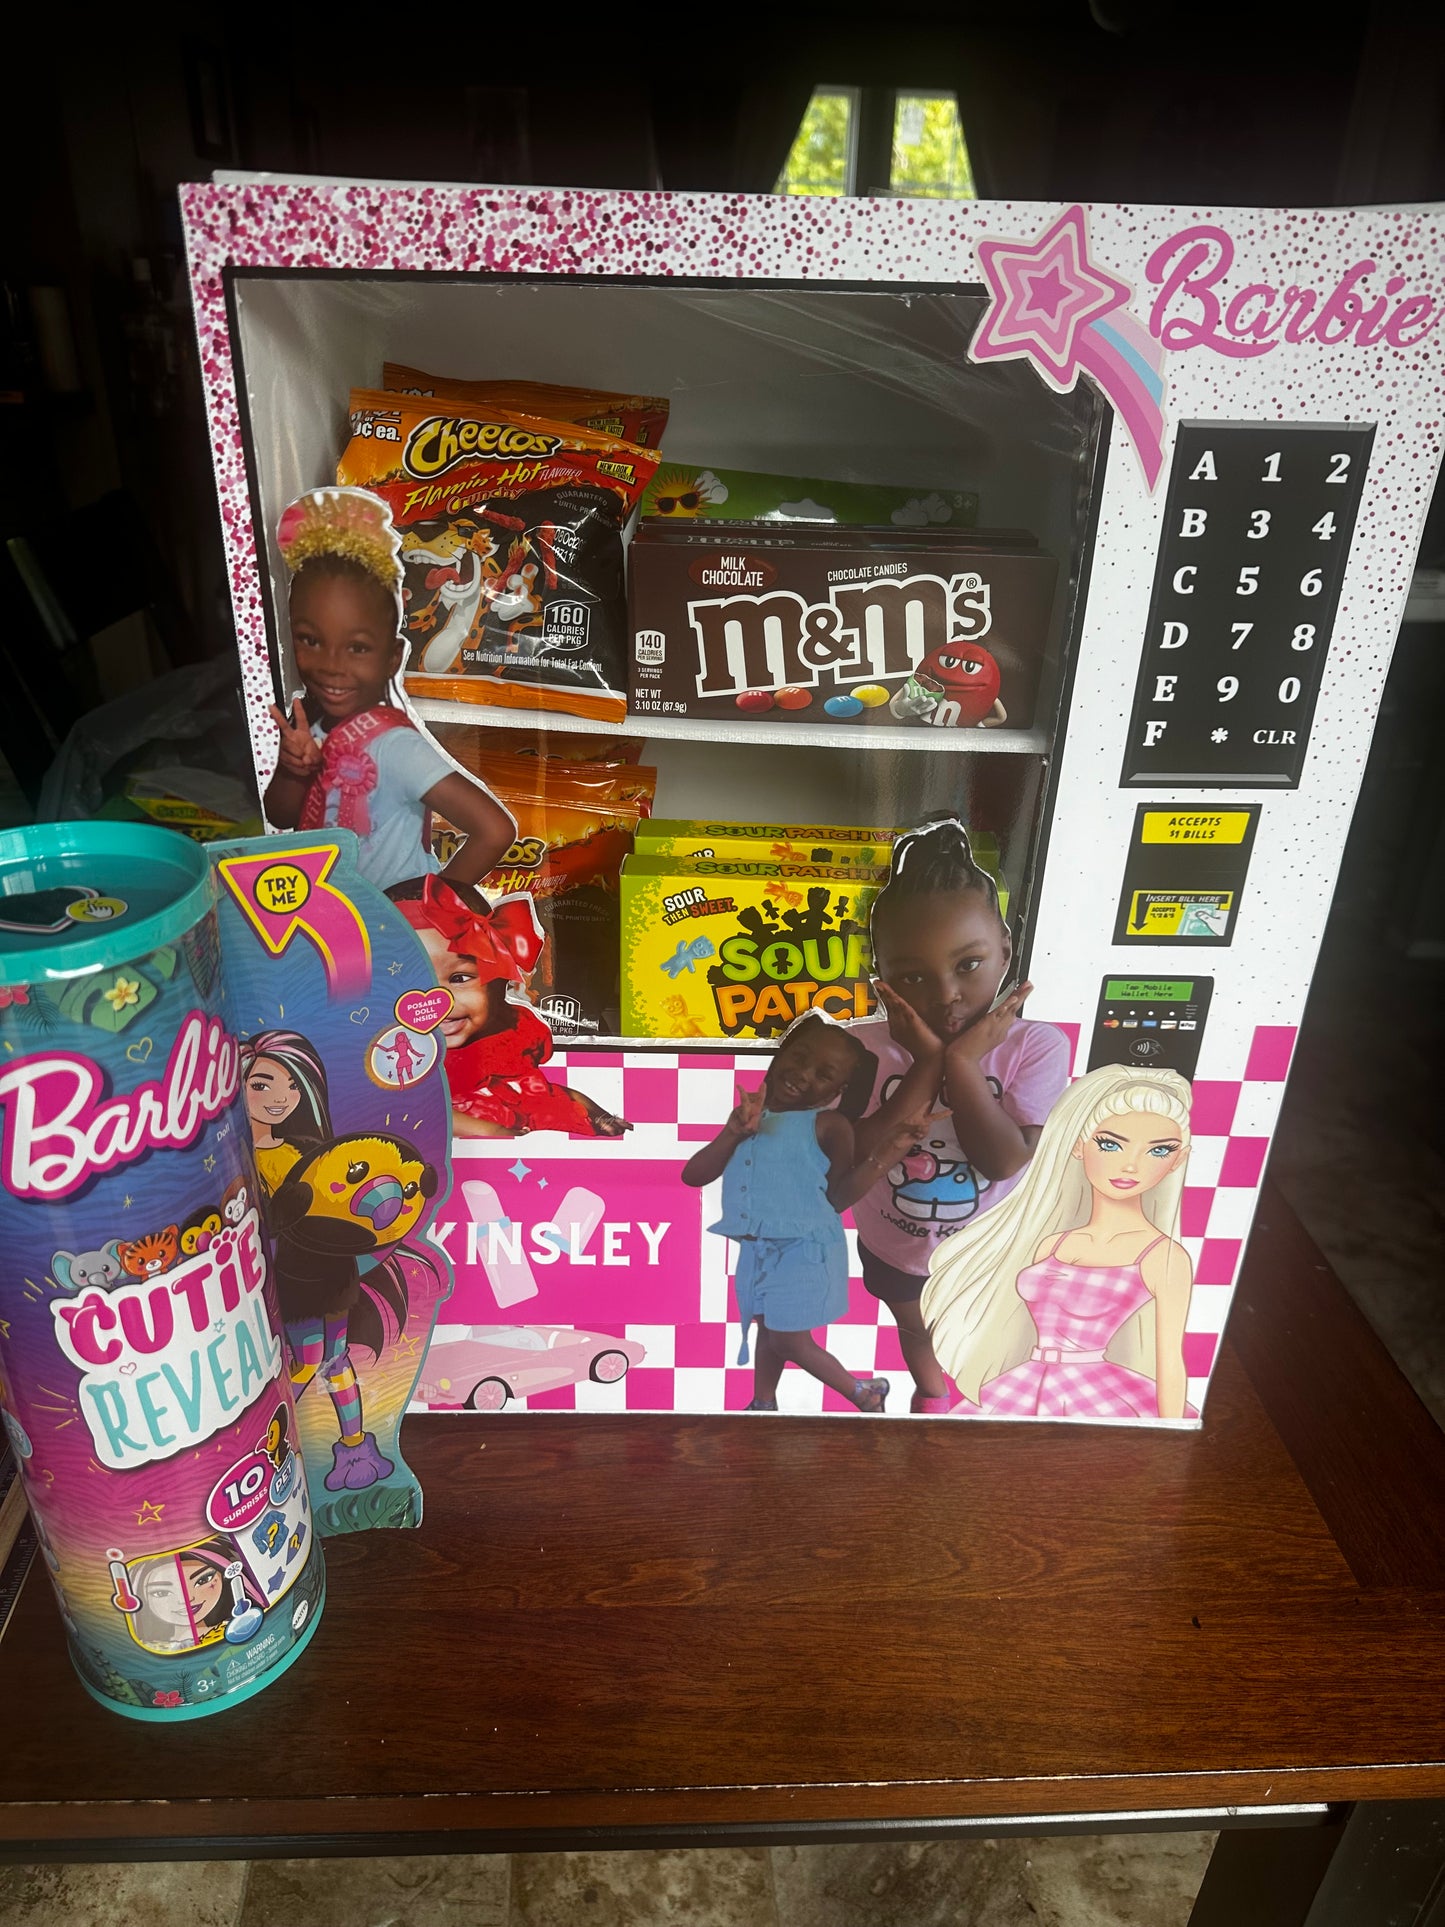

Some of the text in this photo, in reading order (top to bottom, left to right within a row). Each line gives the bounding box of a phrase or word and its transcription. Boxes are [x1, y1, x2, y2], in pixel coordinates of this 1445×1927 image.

[1145, 225, 1445, 358] Barbie
[404, 417, 561, 477] Cheetos
[497, 461, 549, 486] Hot
[539, 466, 582, 482] FLAVORED
[1189, 451, 1351, 483] A 1 2
[446, 486, 528, 514] Crunchy
[1179, 508, 1337, 540] B 3 4
[721, 556, 746, 571] MILK
[827, 563, 908, 582] CHOCOLATE CANDIES
[702, 570, 763, 587] CHOCOLATE
[1172, 566, 1323, 597] C 5 6
[551, 606, 584, 625] 160
[546, 624, 585, 636] CALORIES
[1160, 622, 1316, 651] D 7 8
[549, 634, 582, 646] PER PKG
[640, 633, 661, 649] 140
[463, 650, 475, 661] See
[476, 651, 502, 663] Nutrition
[504, 653, 540, 666] Information
[541, 656, 550, 667] for
[551, 657, 567, 669] Total
[635, 688, 662, 699] NET WT
[1152, 676, 1301, 703] E 9 0
[635, 700, 687, 713] 3.10 OZ (87.9g)
[1143, 721, 1167, 746] F
[1253, 729, 1297, 745] CLR
[1168, 817, 1222, 826] ACCEPTS
[705, 825, 784, 838] SOUR
[784, 828, 870, 841] PATCH
[1169, 830, 1216, 839] $1 BILLS
[497, 869, 541, 893] Hot
[695, 862, 779, 876] SOUR
[779, 864, 872, 881] PATCH
[264, 875, 298, 893] TRY
[272, 891, 297, 906] ME
[664, 887, 706, 912] SOUR
[1146, 894, 1177, 902] INSERT
[1198, 895, 1221, 903] HERE
[663, 907, 689, 925] THEN
[407, 997, 442, 1011] POSABLE
[415, 1007, 435, 1016] DOLL
[547, 999, 575, 1018] 160
[413, 1013, 438, 1023] INSIDE
[0, 1017, 239, 1191] Barbie
[217, 1122, 230, 1141] Doll
[426, 1221, 671, 1266] KINSLEY
[60, 1222, 263, 1366] CUTIE
[86, 1298, 279, 1458] REVEAL
[224, 1465, 264, 1507] 10
[275, 1462, 292, 1493] PET
[222, 1486, 268, 1525] SURPRISES
[197, 1680, 216, 1693] 3+
